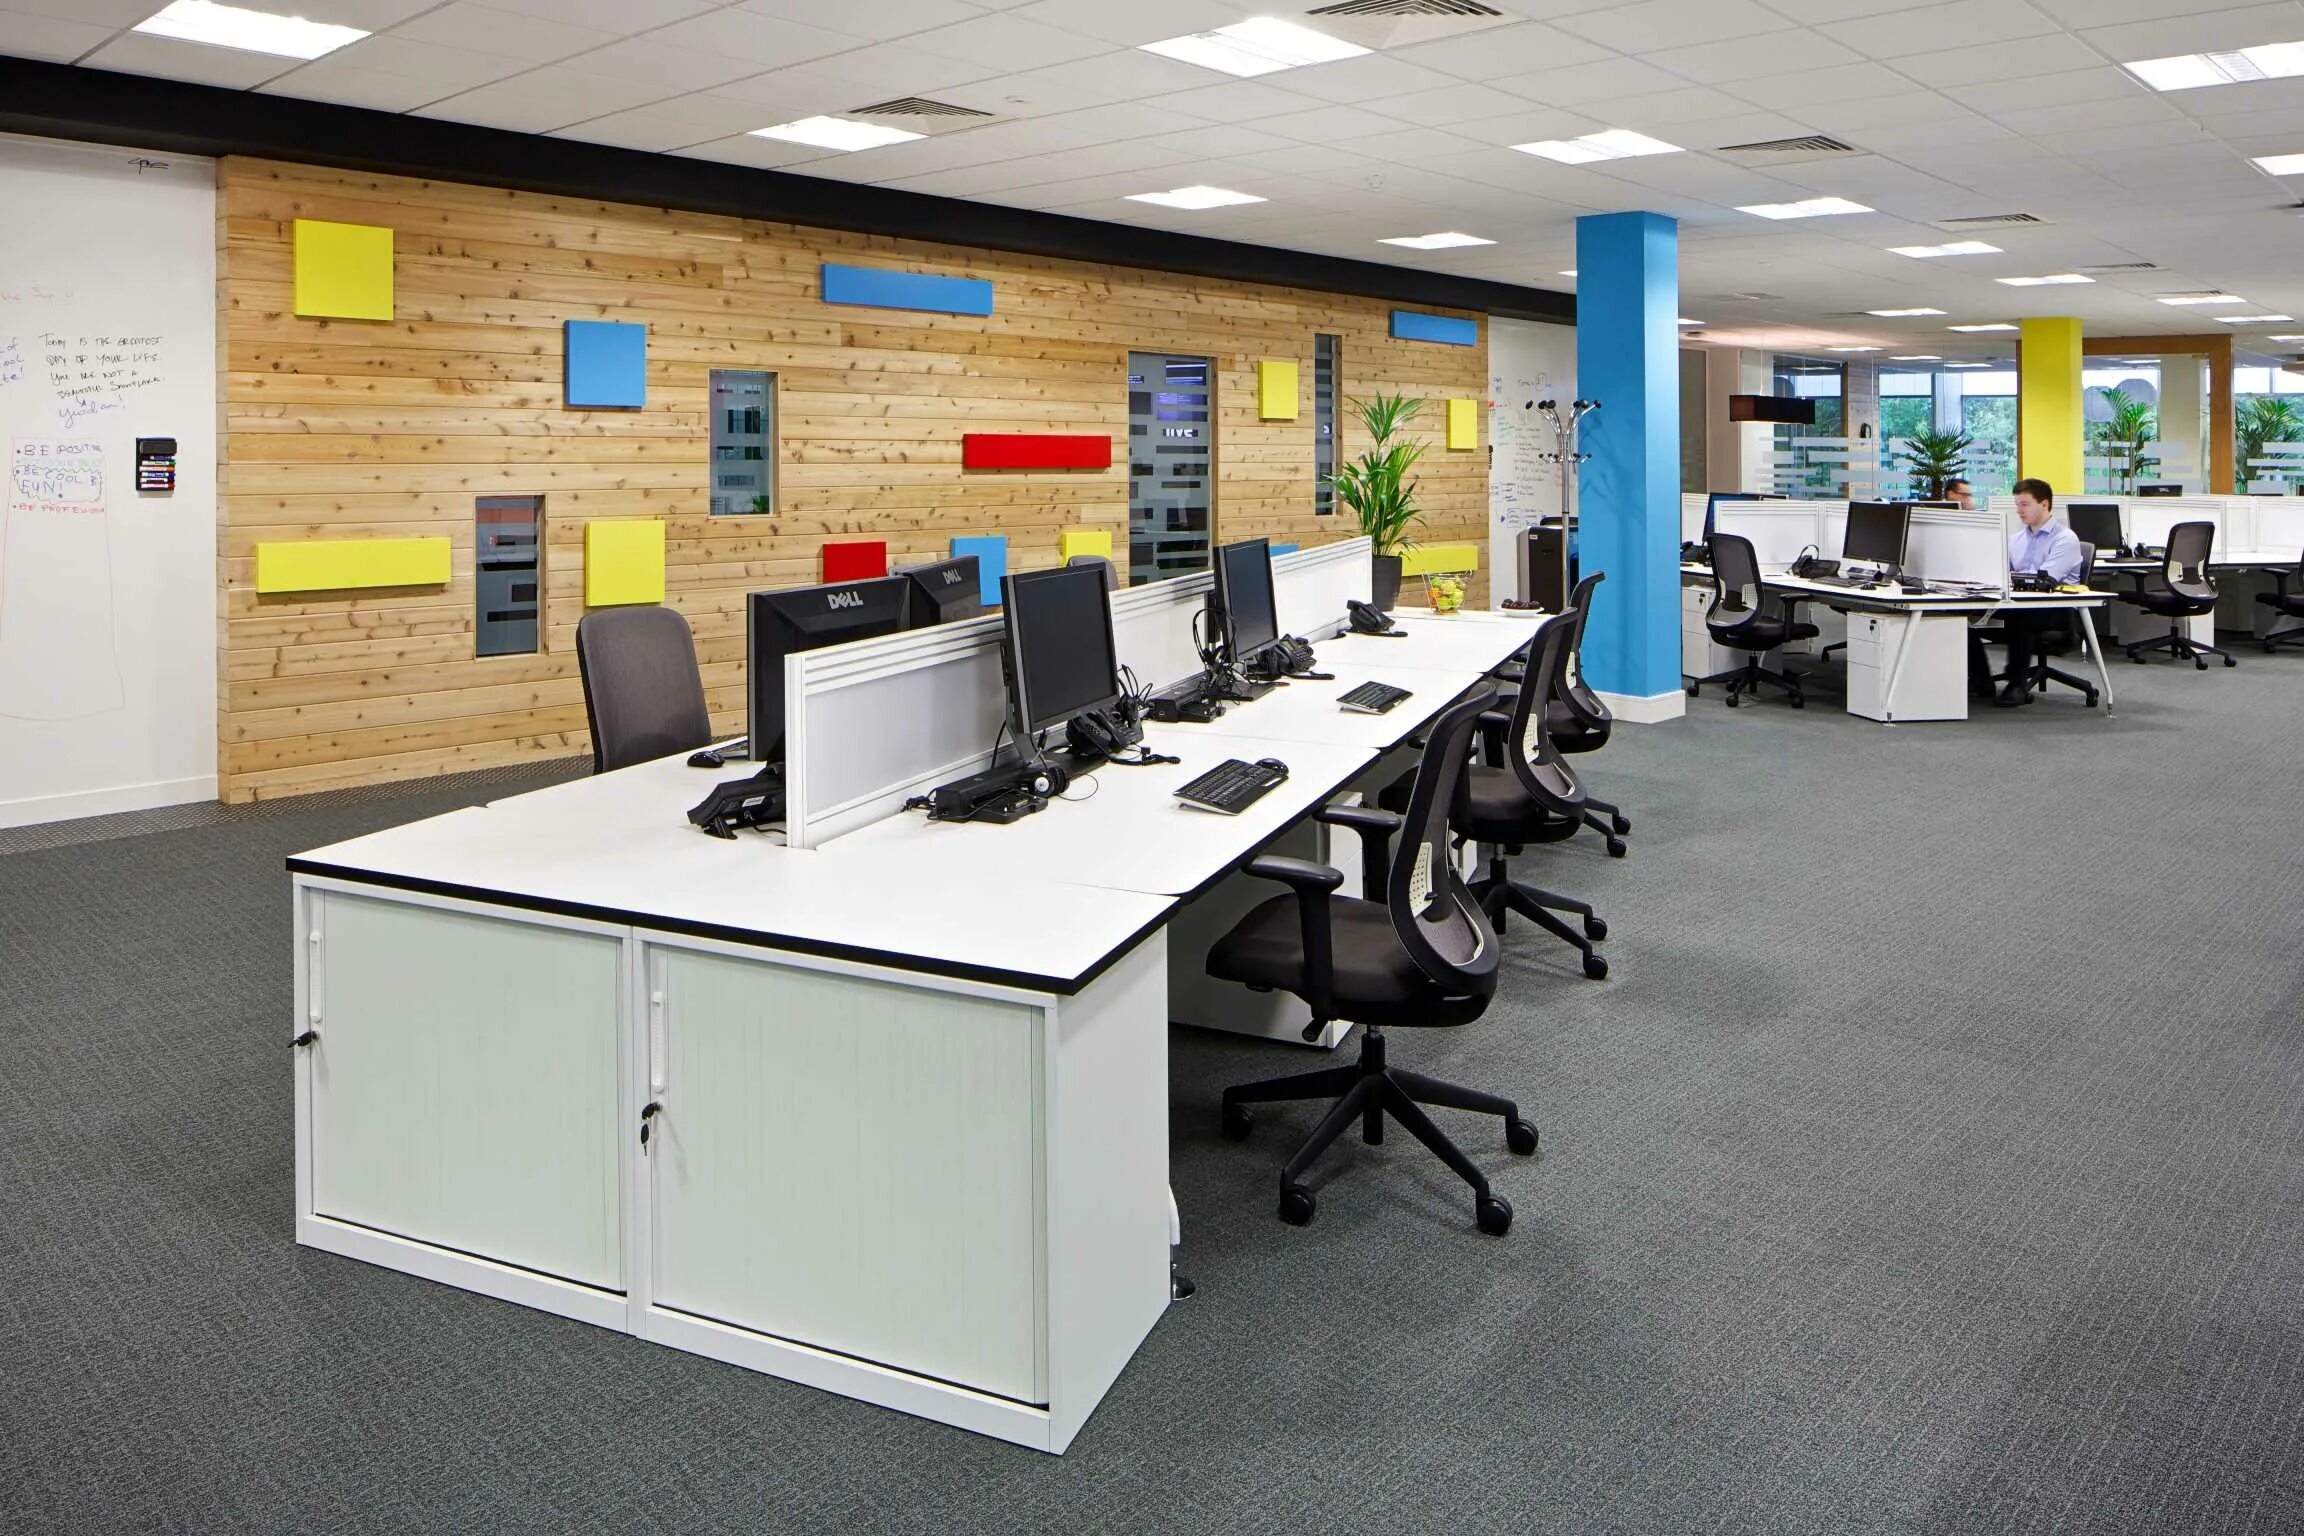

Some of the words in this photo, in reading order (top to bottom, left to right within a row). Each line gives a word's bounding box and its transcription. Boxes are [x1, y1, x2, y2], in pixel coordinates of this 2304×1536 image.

[23, 444, 49, 456] BE
[45, 468, 84, 484] COOL
[943, 568, 962, 585] DELL
[826, 591, 864, 610] DELL
